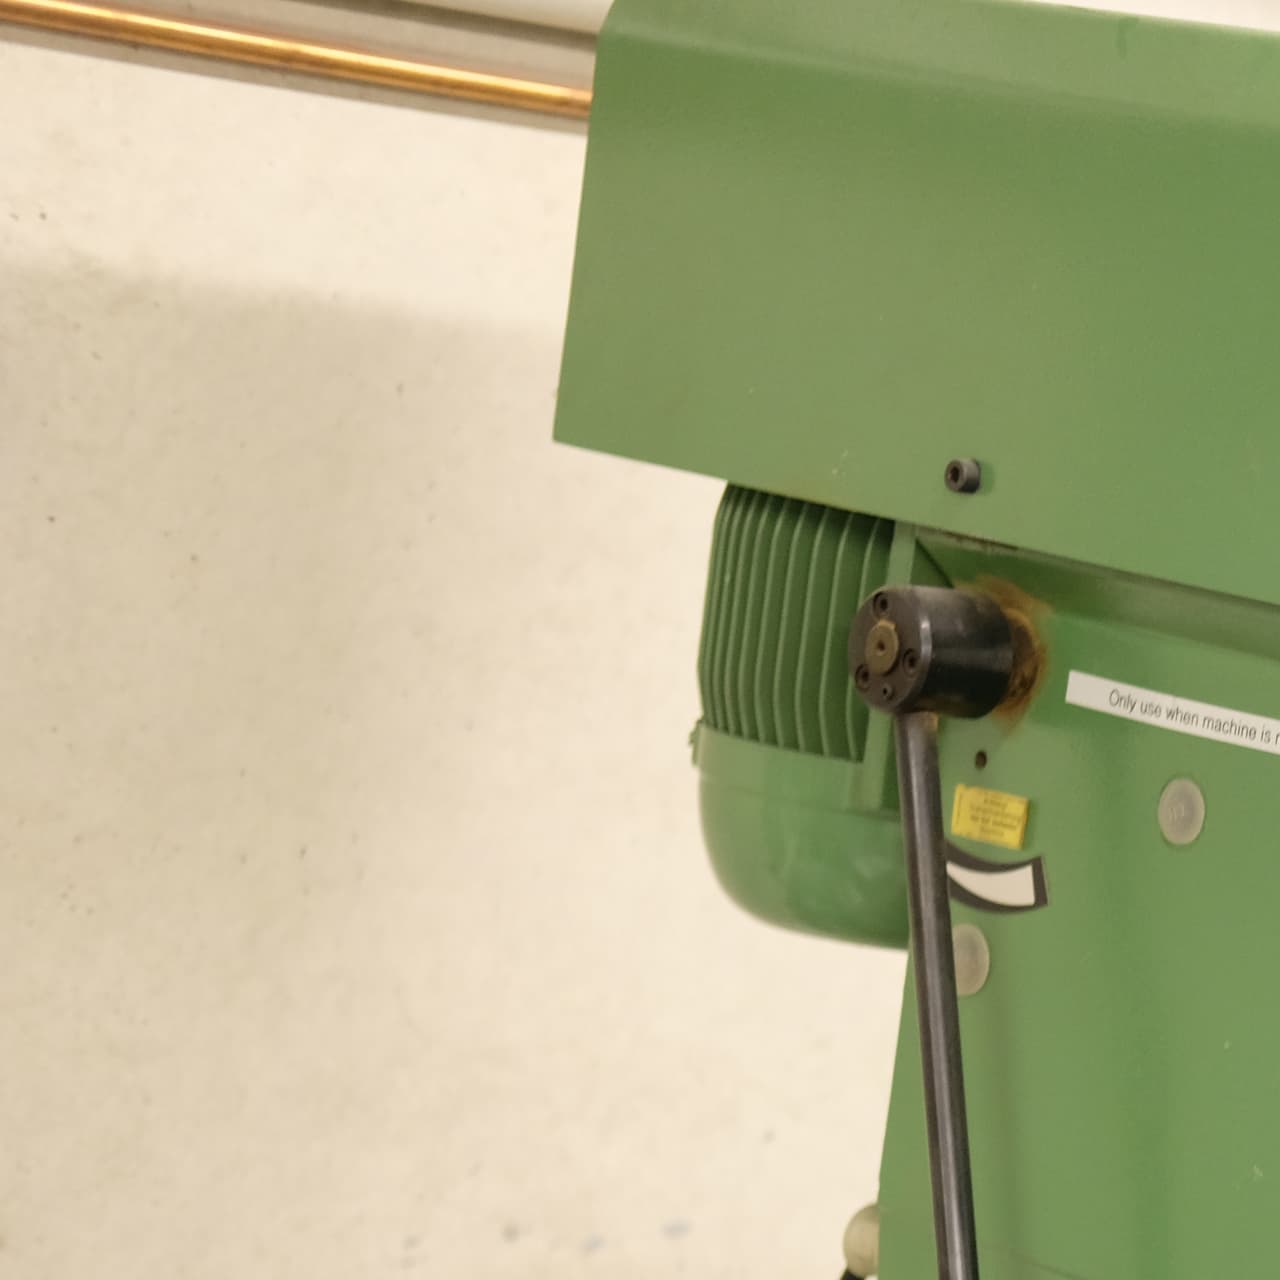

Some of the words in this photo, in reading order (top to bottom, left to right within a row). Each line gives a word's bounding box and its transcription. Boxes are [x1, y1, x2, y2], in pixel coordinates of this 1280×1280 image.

[1108, 688, 1138, 713] Only
[1139, 700, 1163, 718] use
[1165, 705, 1200, 726] when
[1201, 715, 1258, 741] machine
[1260, 724, 1272, 743] is
